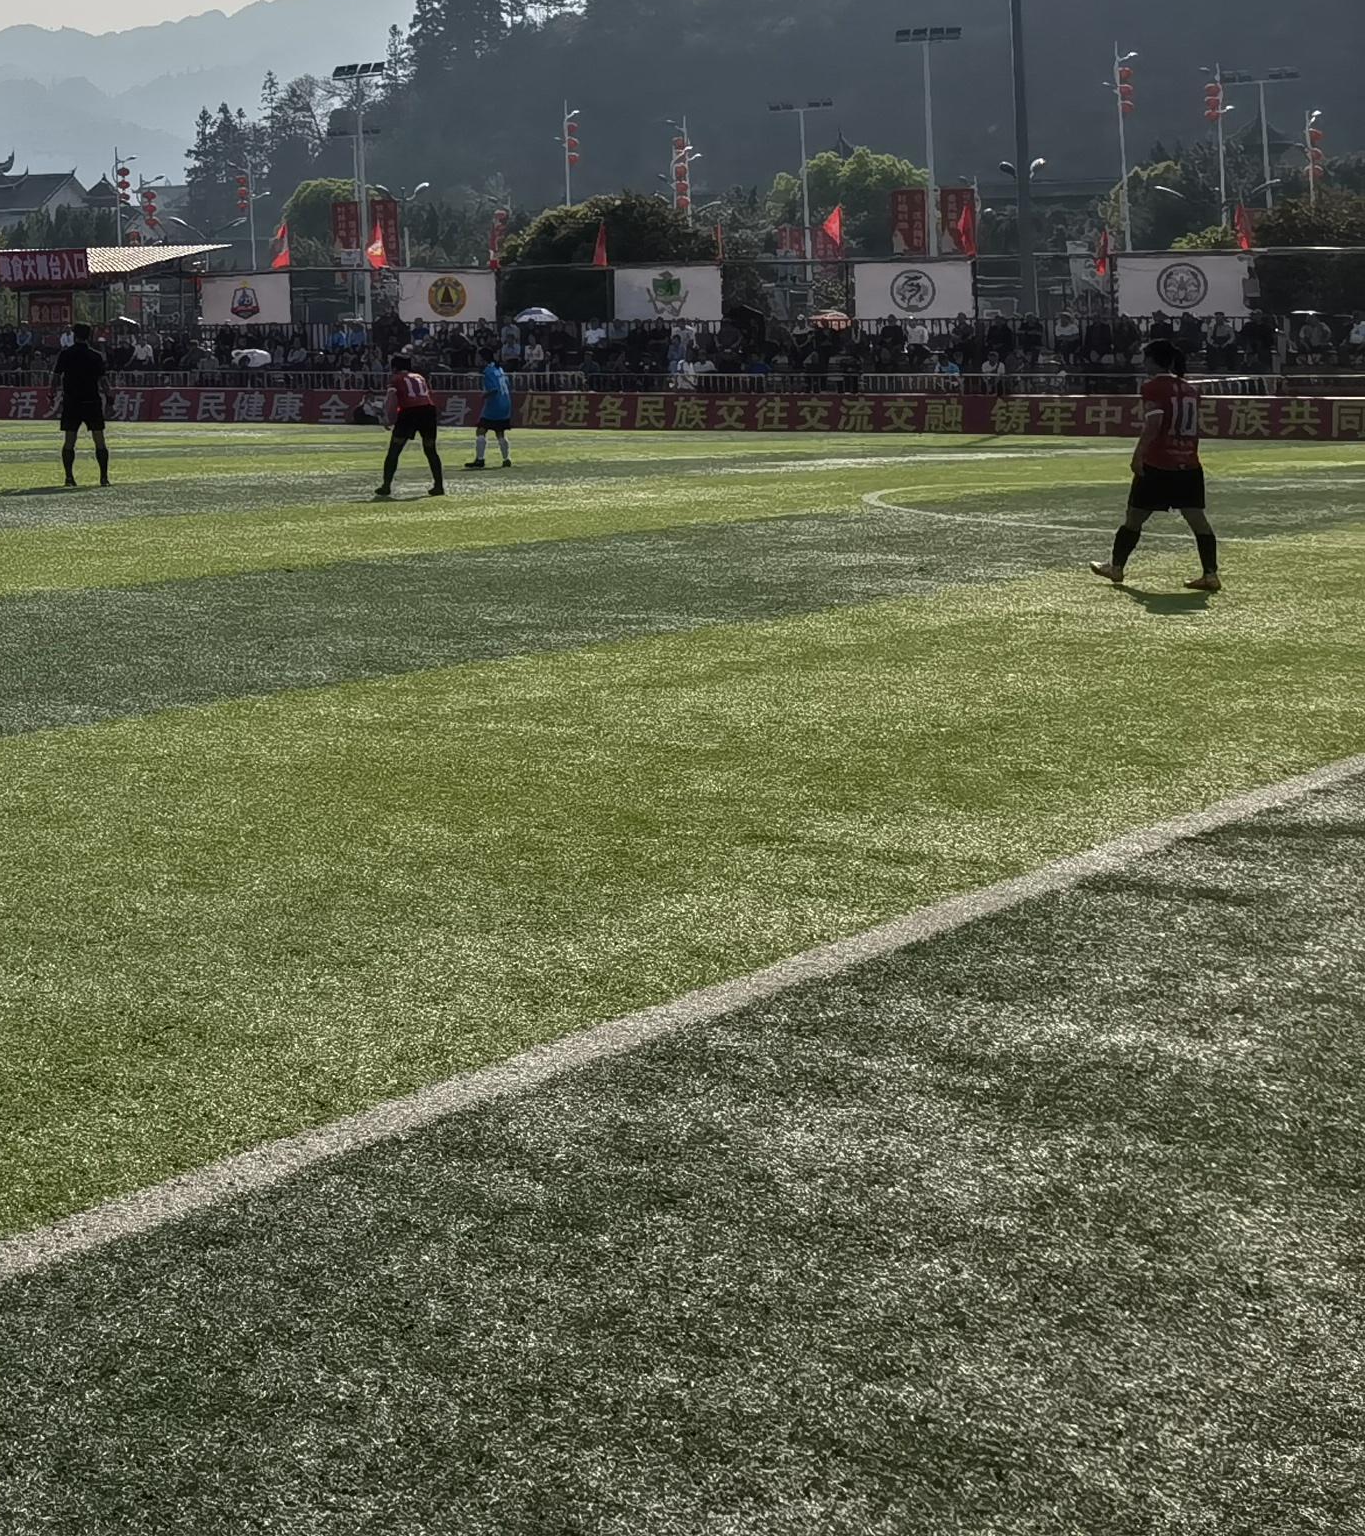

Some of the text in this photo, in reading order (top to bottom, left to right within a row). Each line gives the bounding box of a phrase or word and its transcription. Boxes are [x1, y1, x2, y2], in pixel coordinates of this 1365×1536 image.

[159, 392, 303, 422] 全民健康
[520, 395, 963, 433] 促进各民族交往交流交融
[1168, 396, 1197, 436] 10
